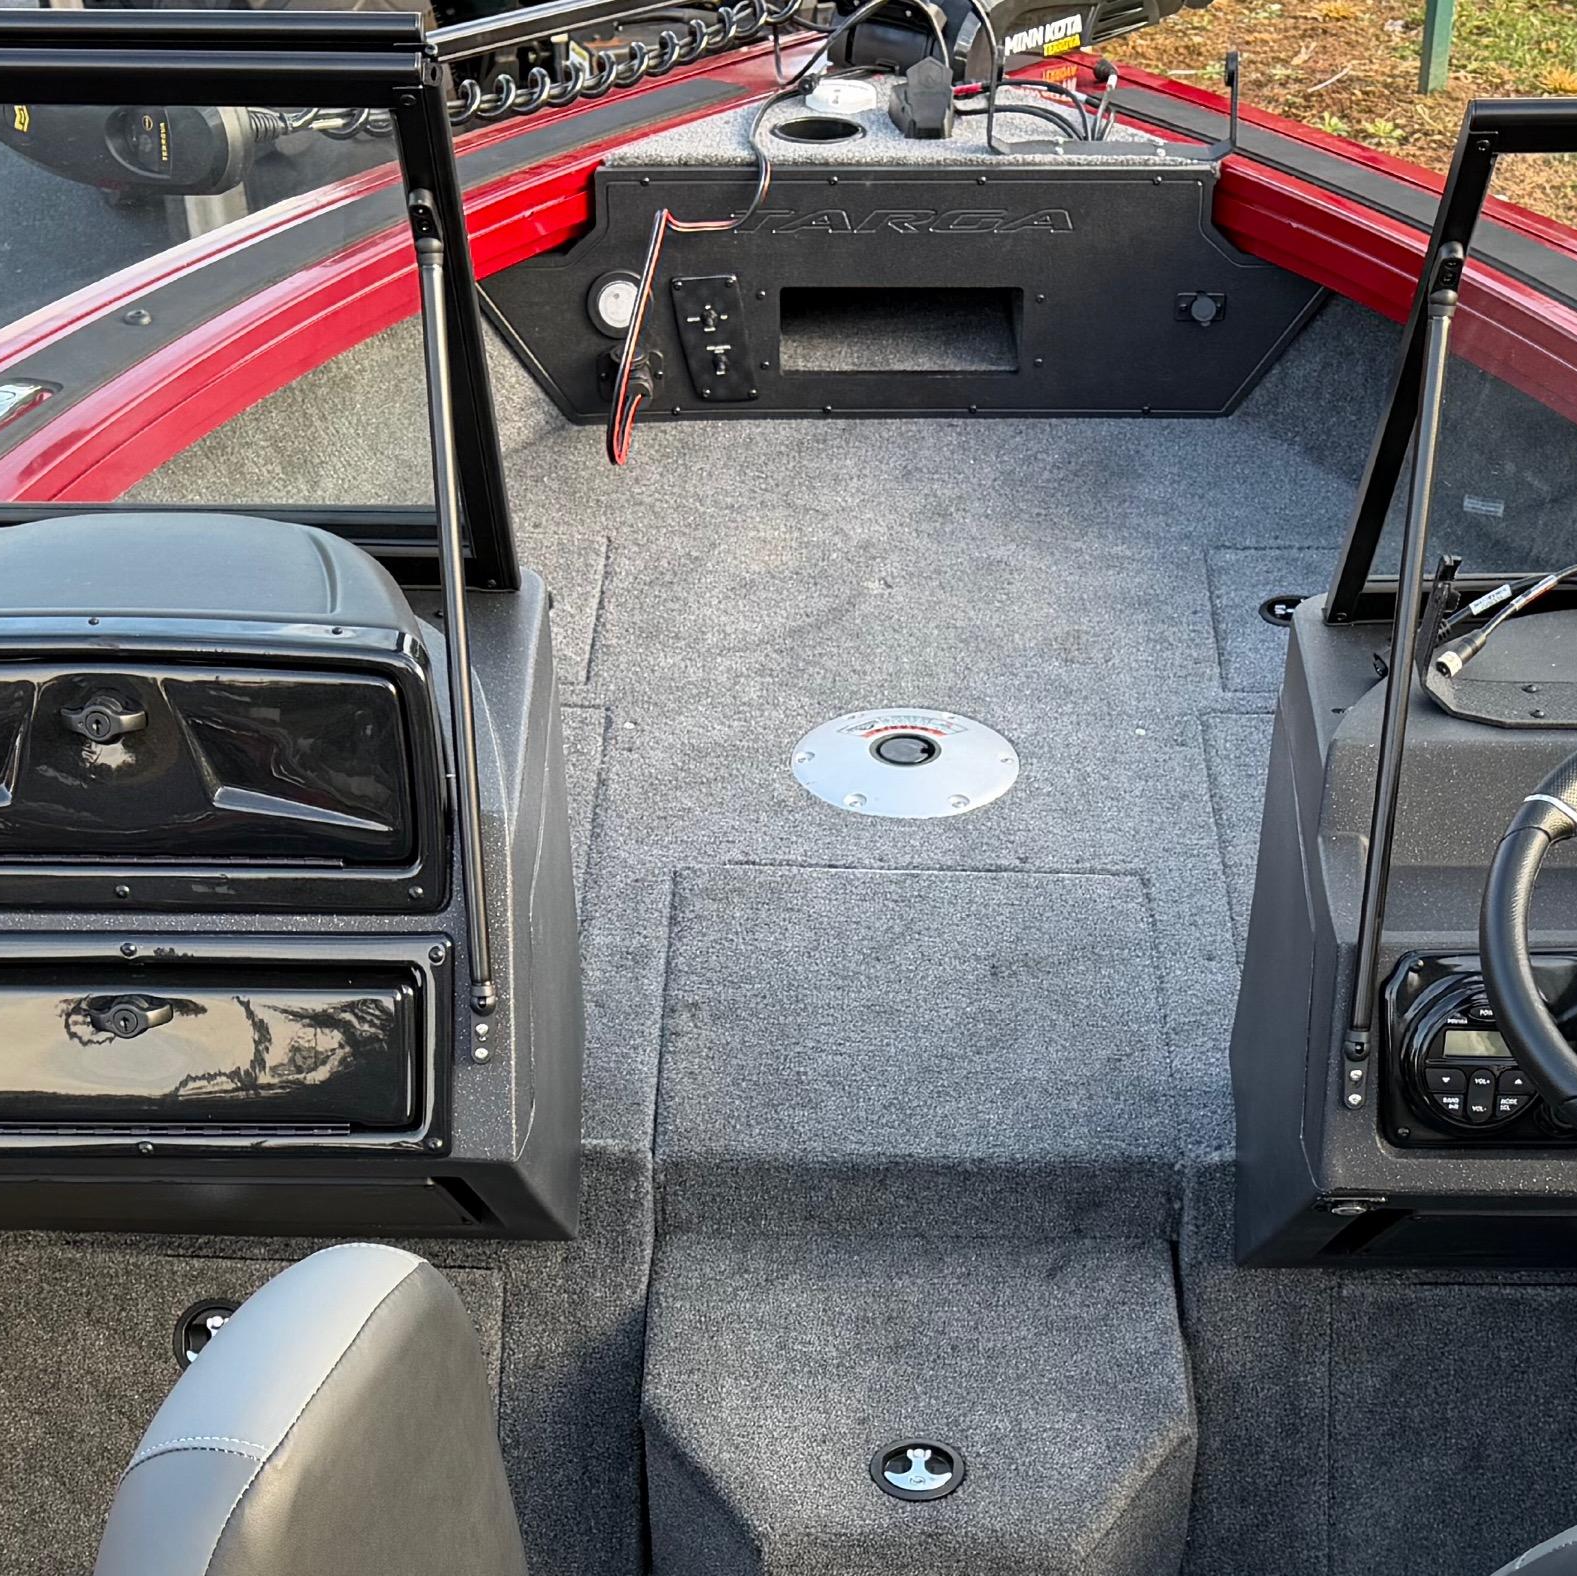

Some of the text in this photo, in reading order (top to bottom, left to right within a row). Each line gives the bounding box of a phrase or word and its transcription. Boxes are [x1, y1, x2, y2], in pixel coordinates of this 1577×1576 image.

[1004, 13, 1082, 57] MINN KOTA
[731, 210, 1073, 234] TARGA
